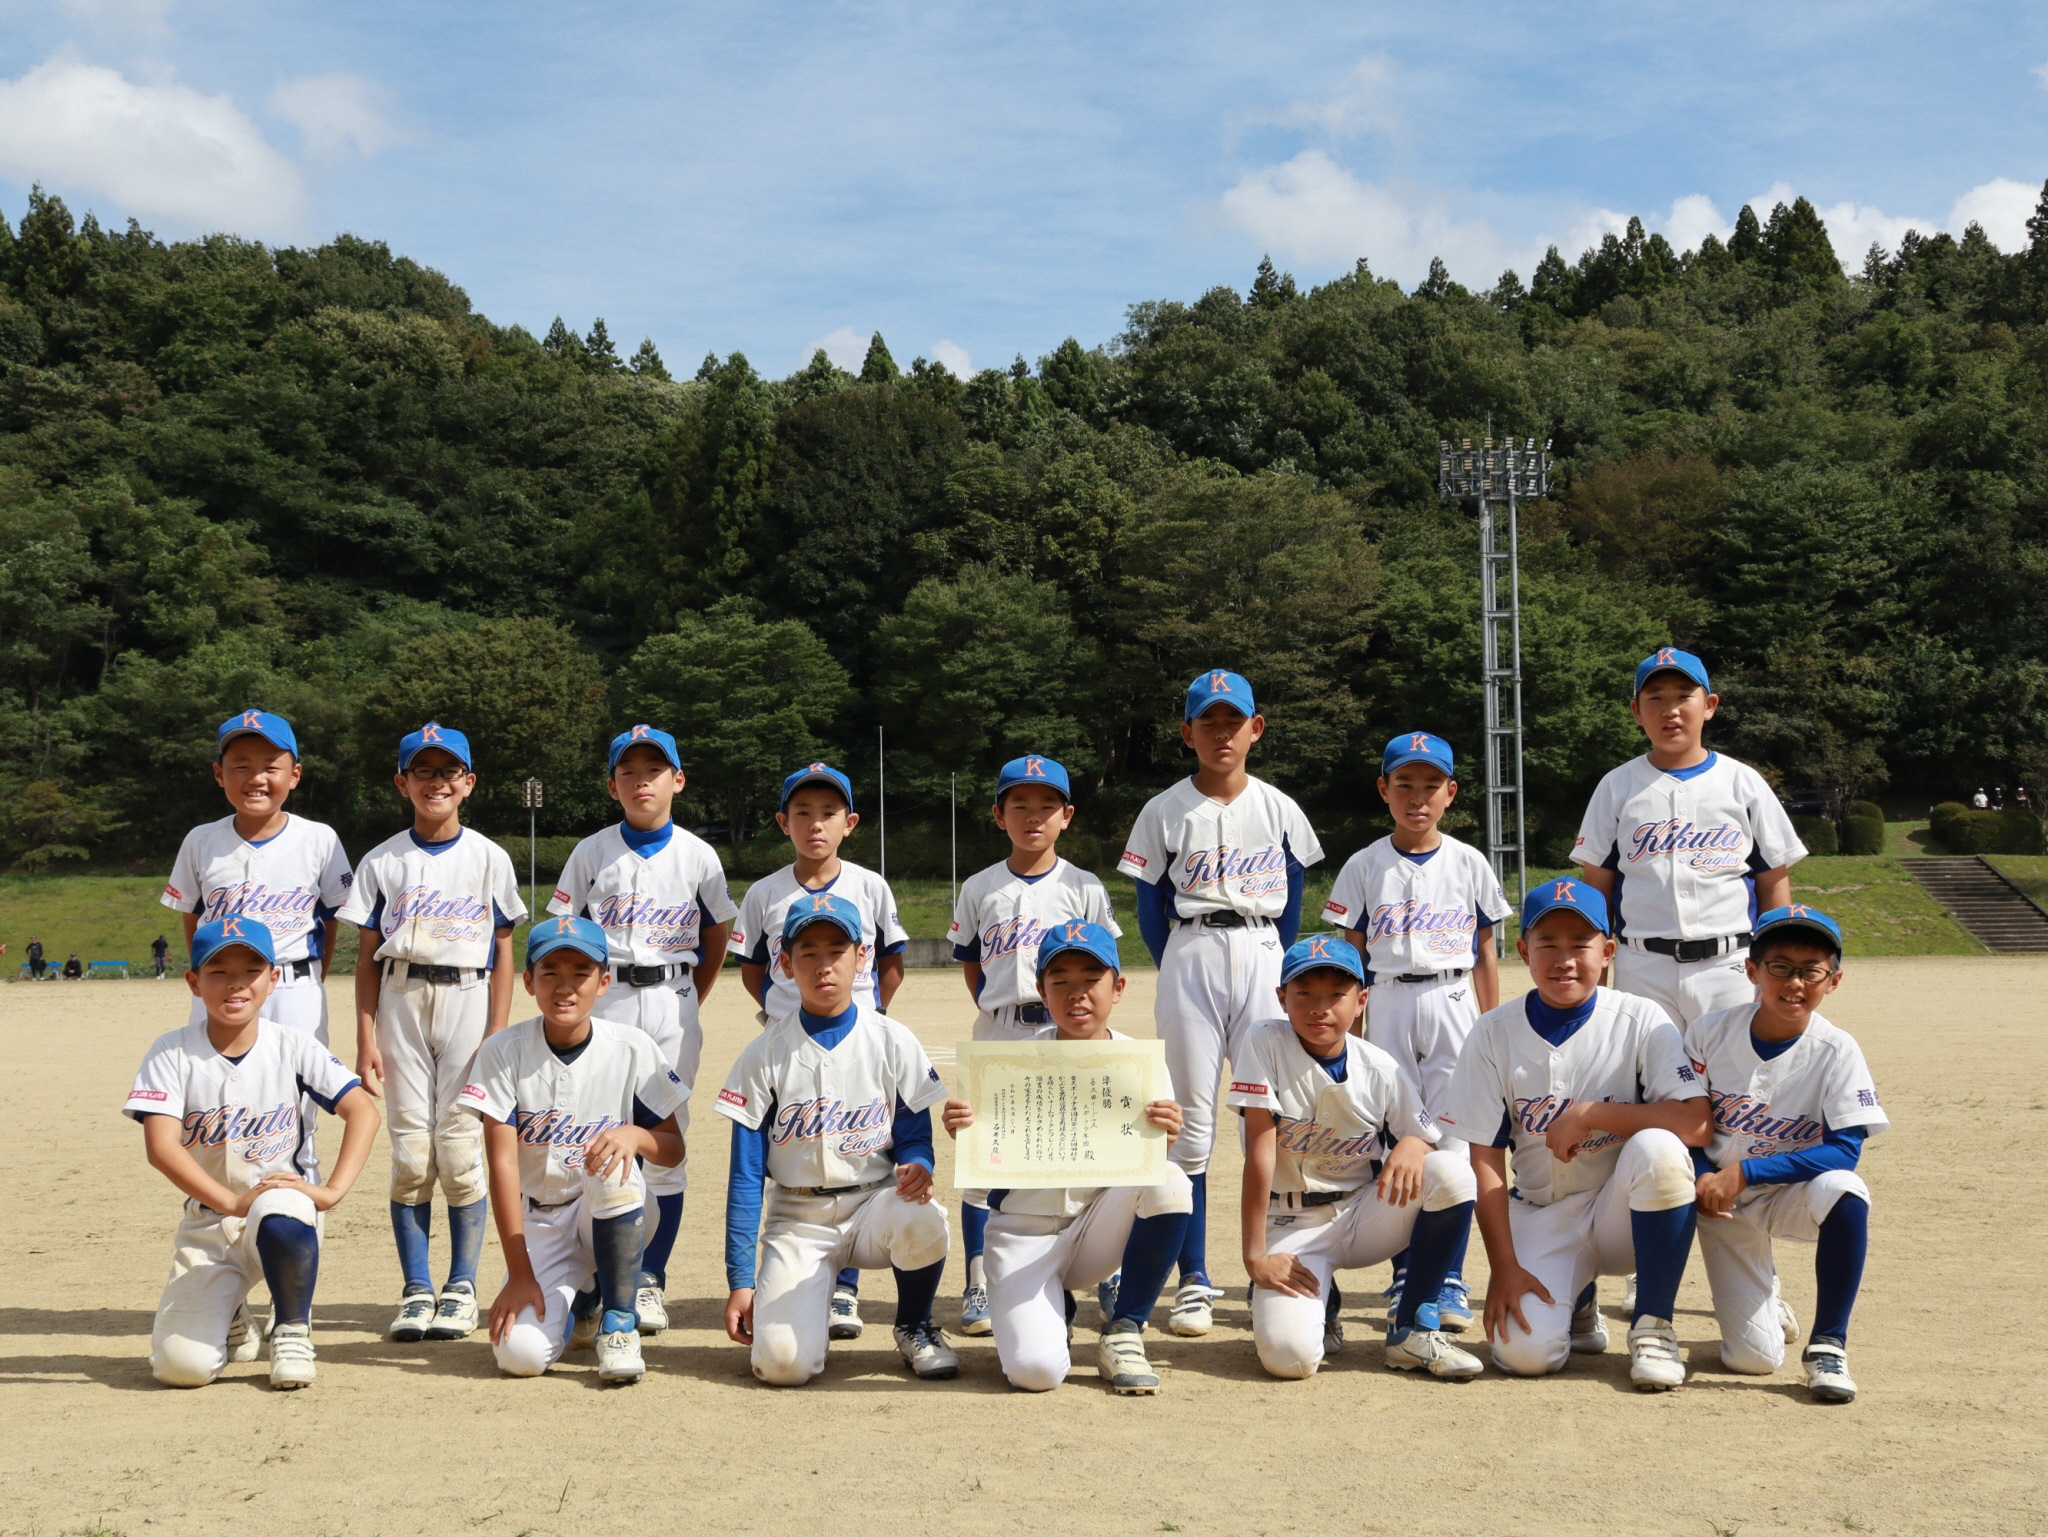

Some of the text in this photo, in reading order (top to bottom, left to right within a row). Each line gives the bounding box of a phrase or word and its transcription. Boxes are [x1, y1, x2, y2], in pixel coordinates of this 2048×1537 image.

[1657, 648, 1676, 666] K
[1211, 673, 1231, 693] K
[243, 711, 262, 729] K
[422, 725, 442, 743] K
[632, 725, 648, 741] K
[1410, 735, 1429, 753] K
[1026, 758, 1045, 777] K
[1627, 817, 1745, 863] Kikuta
[1181, 845, 1287, 893] Kikuta
[1689, 850, 1742, 873] Eagles
[1239, 874, 1288, 898] Eagles
[1553, 881, 1577, 902] K
[204, 880, 319, 923] Kikuta
[597, 891, 702, 930] Kikuta
[813, 893, 836, 912] K
[1786, 904, 1811, 919] K
[222, 917, 246, 937] K
[431, 921, 482, 942] Eagles
[555, 916, 578, 935] K
[1066, 923, 1088, 942] K
[1368, 900, 1478, 945] Kikuta
[645, 929, 696, 951] Eagles
[1308, 939, 1330, 959] K
[1427, 931, 1471, 954] Eagles
[1676, 1065, 1696, 1082] 福
[181, 1101, 298, 1149] Kikuta
[772, 1096, 891, 1147] Kikuta
[1710, 1089, 1824, 1143] Kikuta
[244, 1132, 298, 1163] Eagles
[838, 1132, 891, 1158] Eagles
